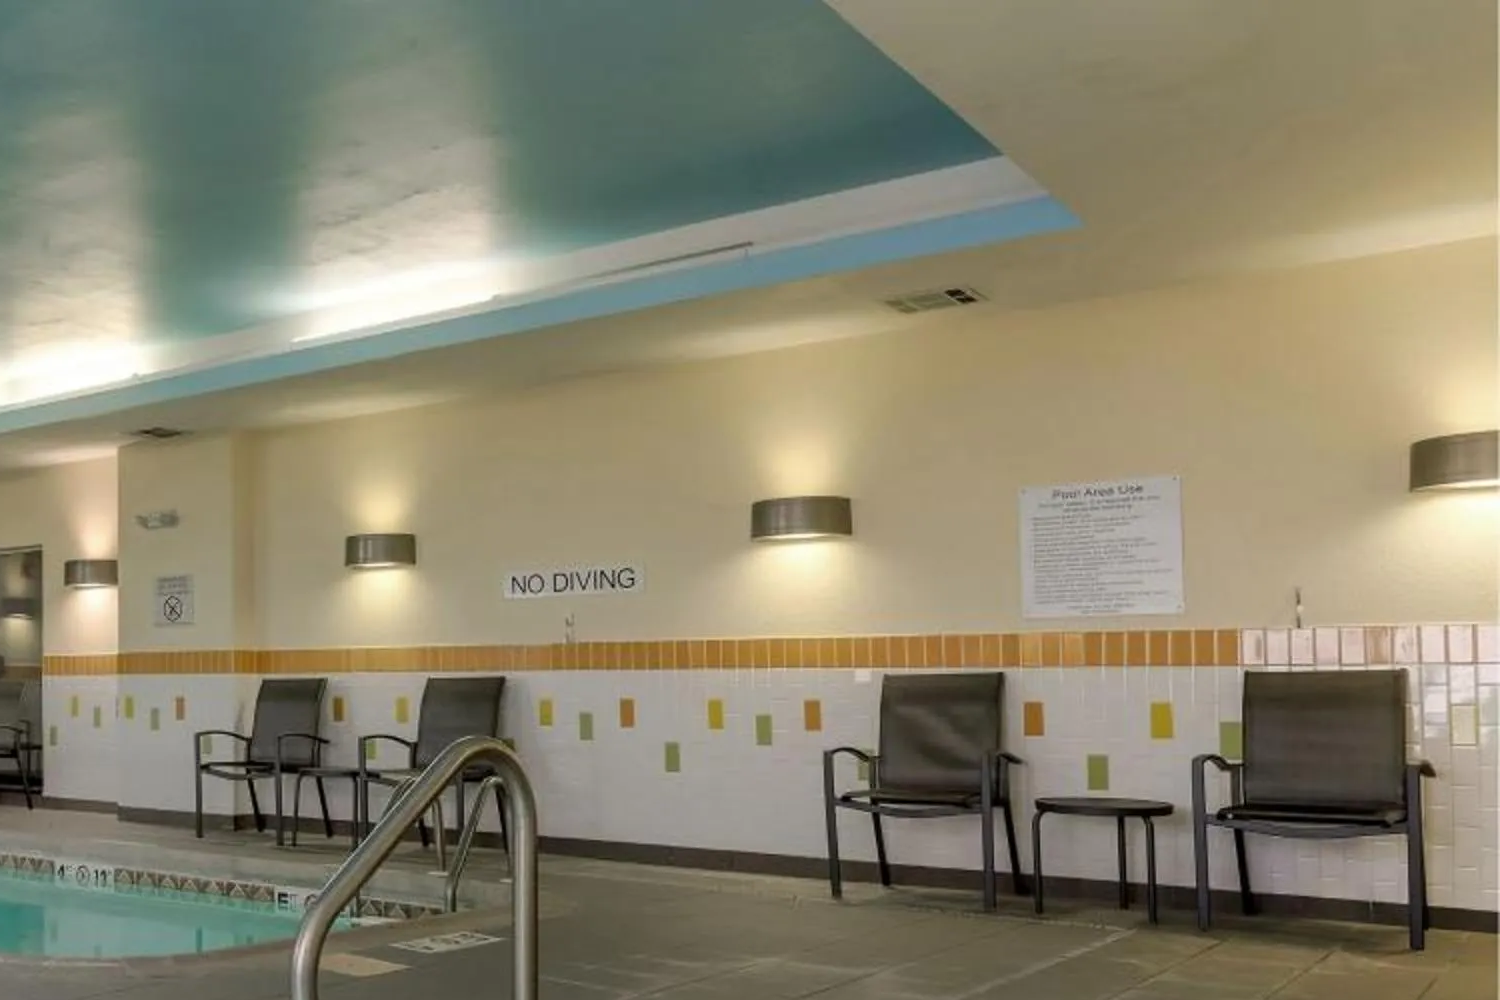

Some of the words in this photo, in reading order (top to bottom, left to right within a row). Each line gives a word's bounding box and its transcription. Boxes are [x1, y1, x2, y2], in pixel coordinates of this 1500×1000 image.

[1084, 486, 1115, 497] Area
[1118, 484, 1144, 495] Use
[510, 573, 545, 594] NO
[553, 567, 636, 593] DIVING
